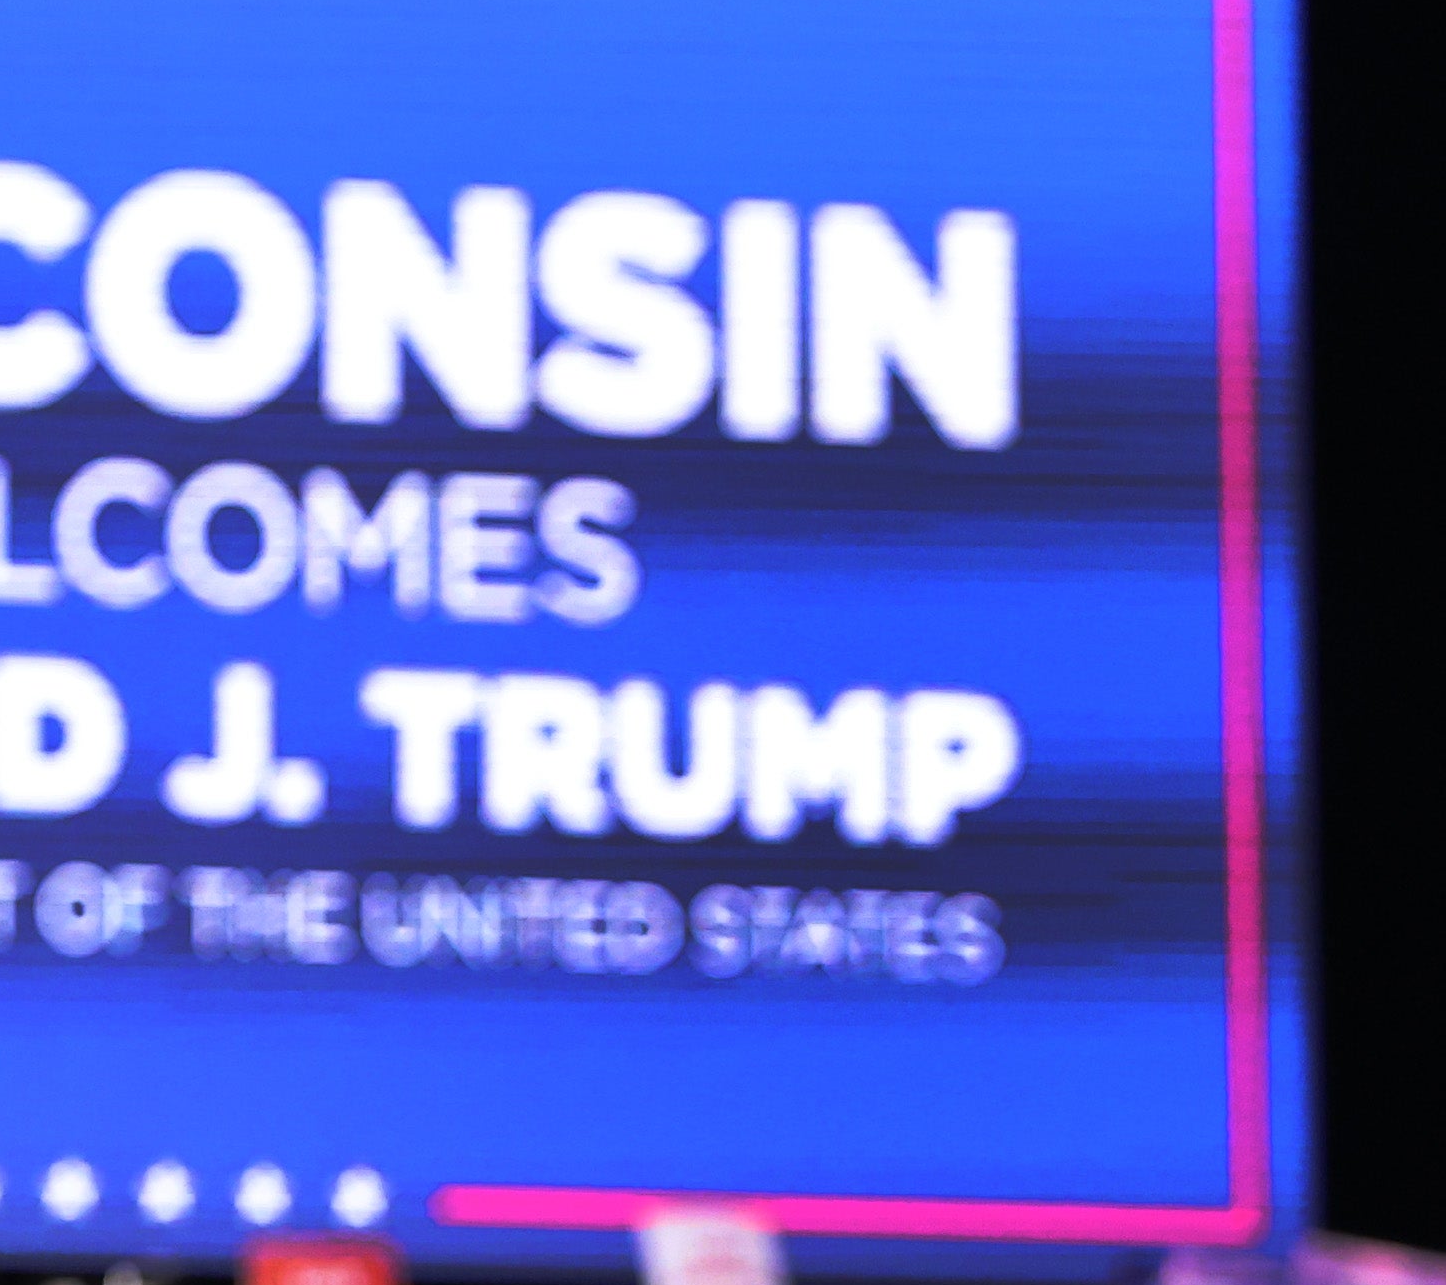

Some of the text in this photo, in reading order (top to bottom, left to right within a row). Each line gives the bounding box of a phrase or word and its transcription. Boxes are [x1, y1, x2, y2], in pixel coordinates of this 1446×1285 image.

[161, 660, 328, 827] J.
[359, 668, 1025, 849] TRUMP
[33, 860, 169, 957] OF
[174, 865, 360, 965] THE
[361, 869, 685, 975] UNITED
[688, 883, 1007, 986] STATES
